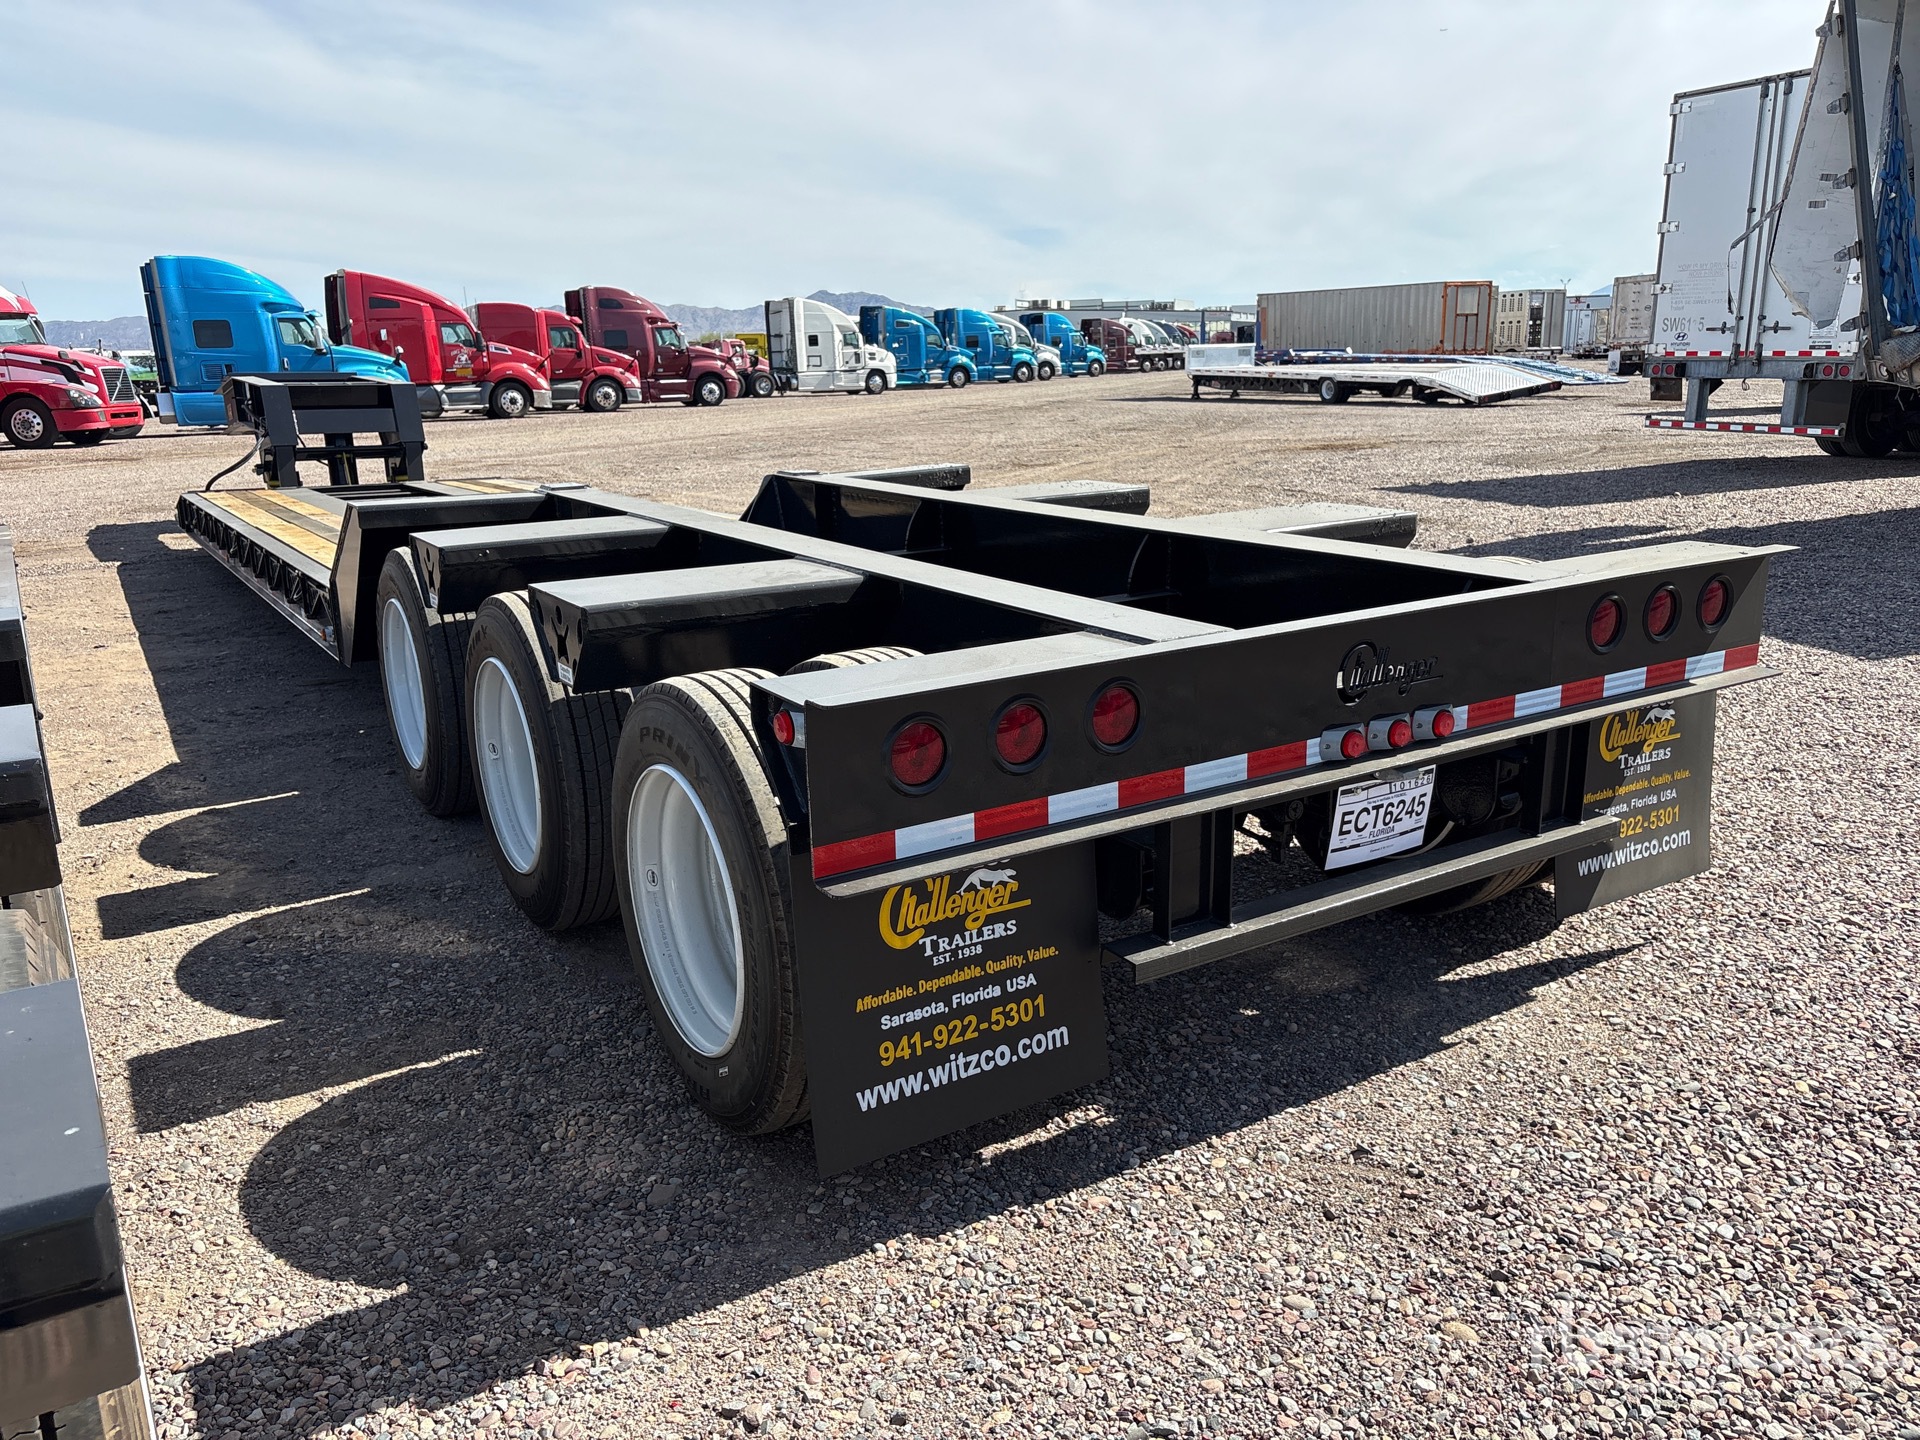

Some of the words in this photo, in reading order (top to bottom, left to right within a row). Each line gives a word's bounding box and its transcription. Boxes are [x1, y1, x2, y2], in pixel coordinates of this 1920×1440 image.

[1662, 317, 1705, 332] SW615
[1336, 639, 1443, 707] Challenger
[1599, 710, 1681, 762] Challenger
[1618, 747, 1671, 769] TRAILERS
[1636, 763, 1651, 775] 1938
[1614, 779, 1650, 796] Dependable.
[1650, 773, 1673, 788] Quality.
[1673, 769, 1691, 781] Value.
[1630, 794, 1658, 810] Florida
[1660, 788, 1678, 801] USA
[1338, 793, 1428, 836] ECT6245
[1368, 825, 1395, 839] FLORIDA
[1577, 829, 1691, 877] www.witzco.com
[878, 875, 1031, 950] Challenger
[919, 920, 1017, 957] TRAILERS
[932, 952, 953, 966] EST.
[957, 944, 983, 960] 1938
[855, 986, 918, 1013] Affordable.
[918, 966, 985, 993] Dependable.
[985, 955, 1026, 975] Quality.
[1026, 945, 1059, 963] Value.
[880, 1001, 949, 1031] Sarasota,
[952, 984, 1001, 1009] Florida
[1006, 972, 1037, 993] USA
[879, 994, 1046, 1067] 941-922-5301
[855, 1025, 1070, 1112] www.witzco.com
